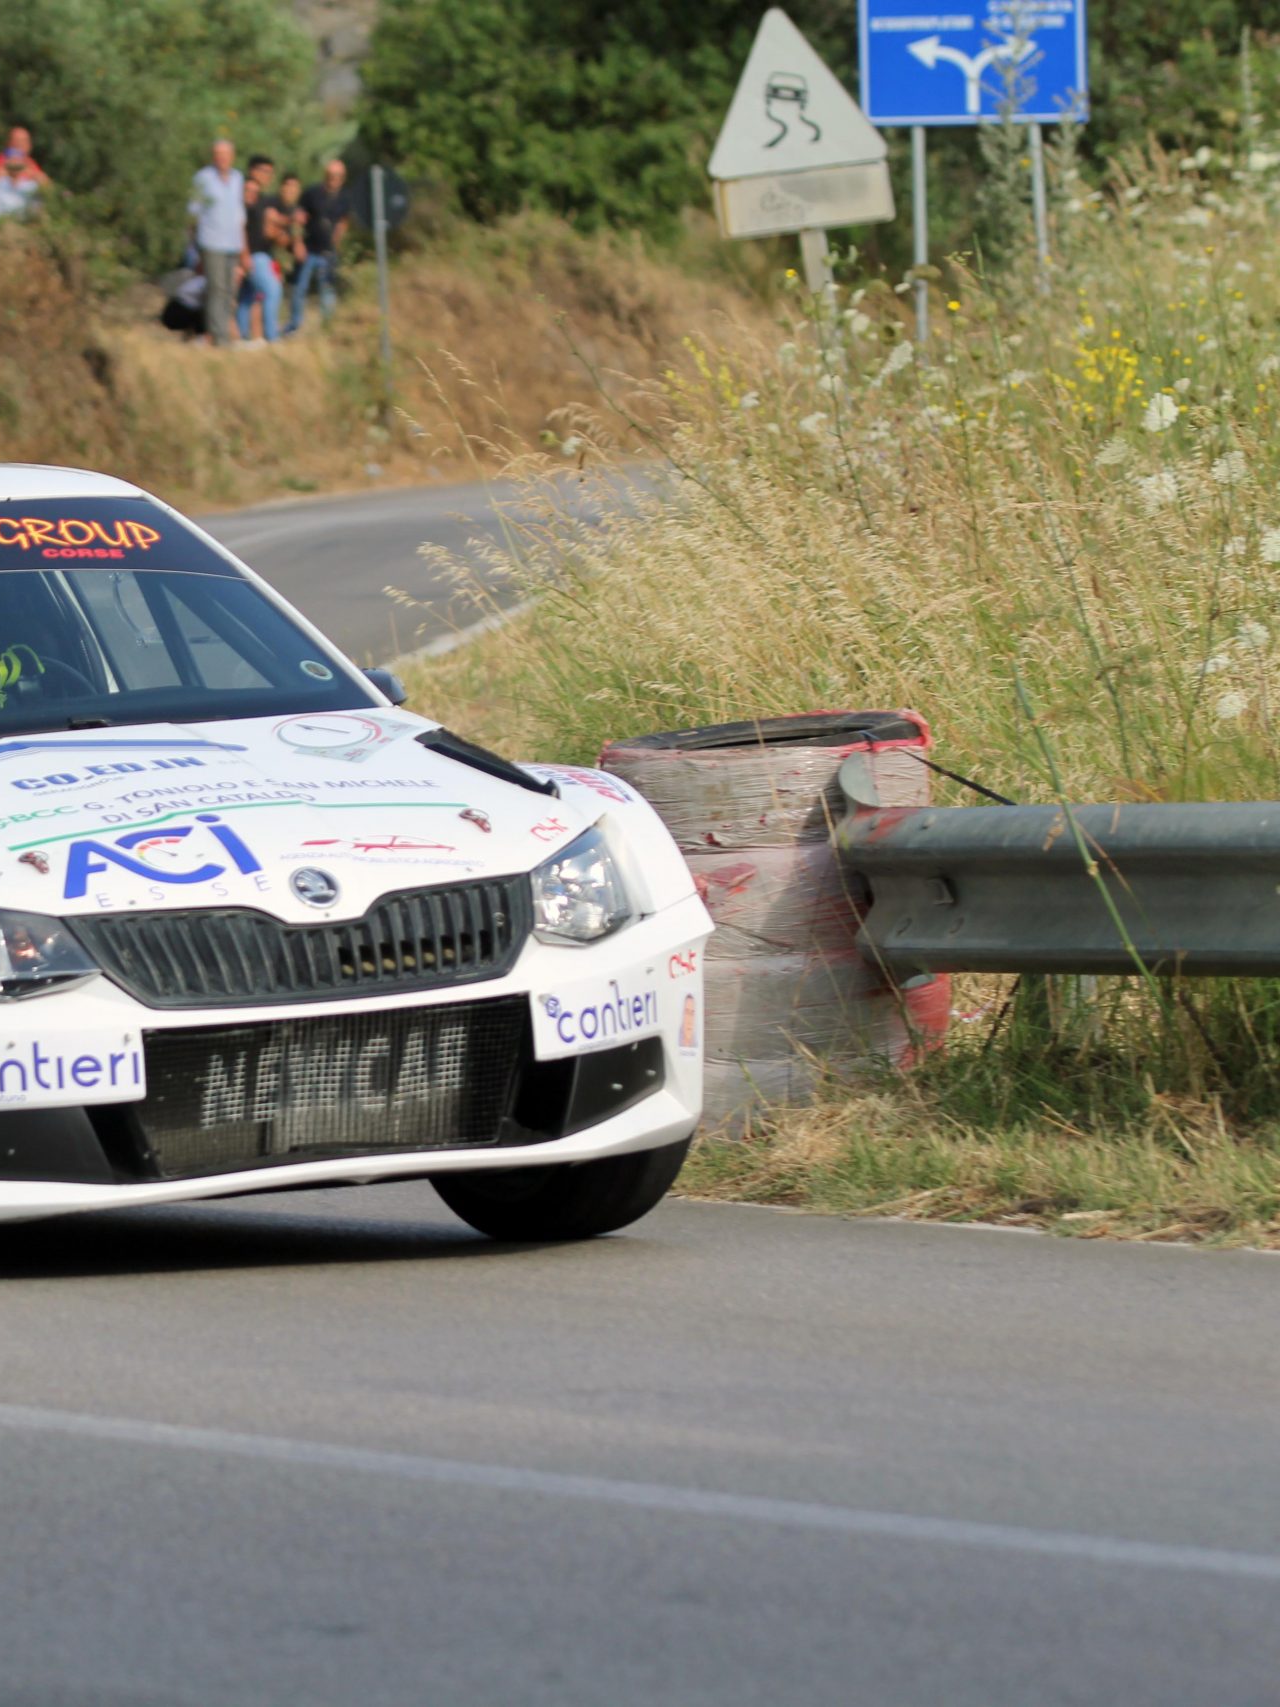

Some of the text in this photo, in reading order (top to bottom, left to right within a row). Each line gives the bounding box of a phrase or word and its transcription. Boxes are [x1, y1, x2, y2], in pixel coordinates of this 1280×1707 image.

[41, 547, 126, 559] CORSE
[7, 804, 80, 824] BCC
[83, 801, 114, 811] G.
[115, 780, 239, 802] TONIOLO
[243, 779, 263, 788] E
[265, 777, 322, 791] SAN
[323, 778, 441, 789] MICHELE
[101, 789, 316, 824] DI SAN CATALDO
[557, 979, 658, 1044] cantieri
